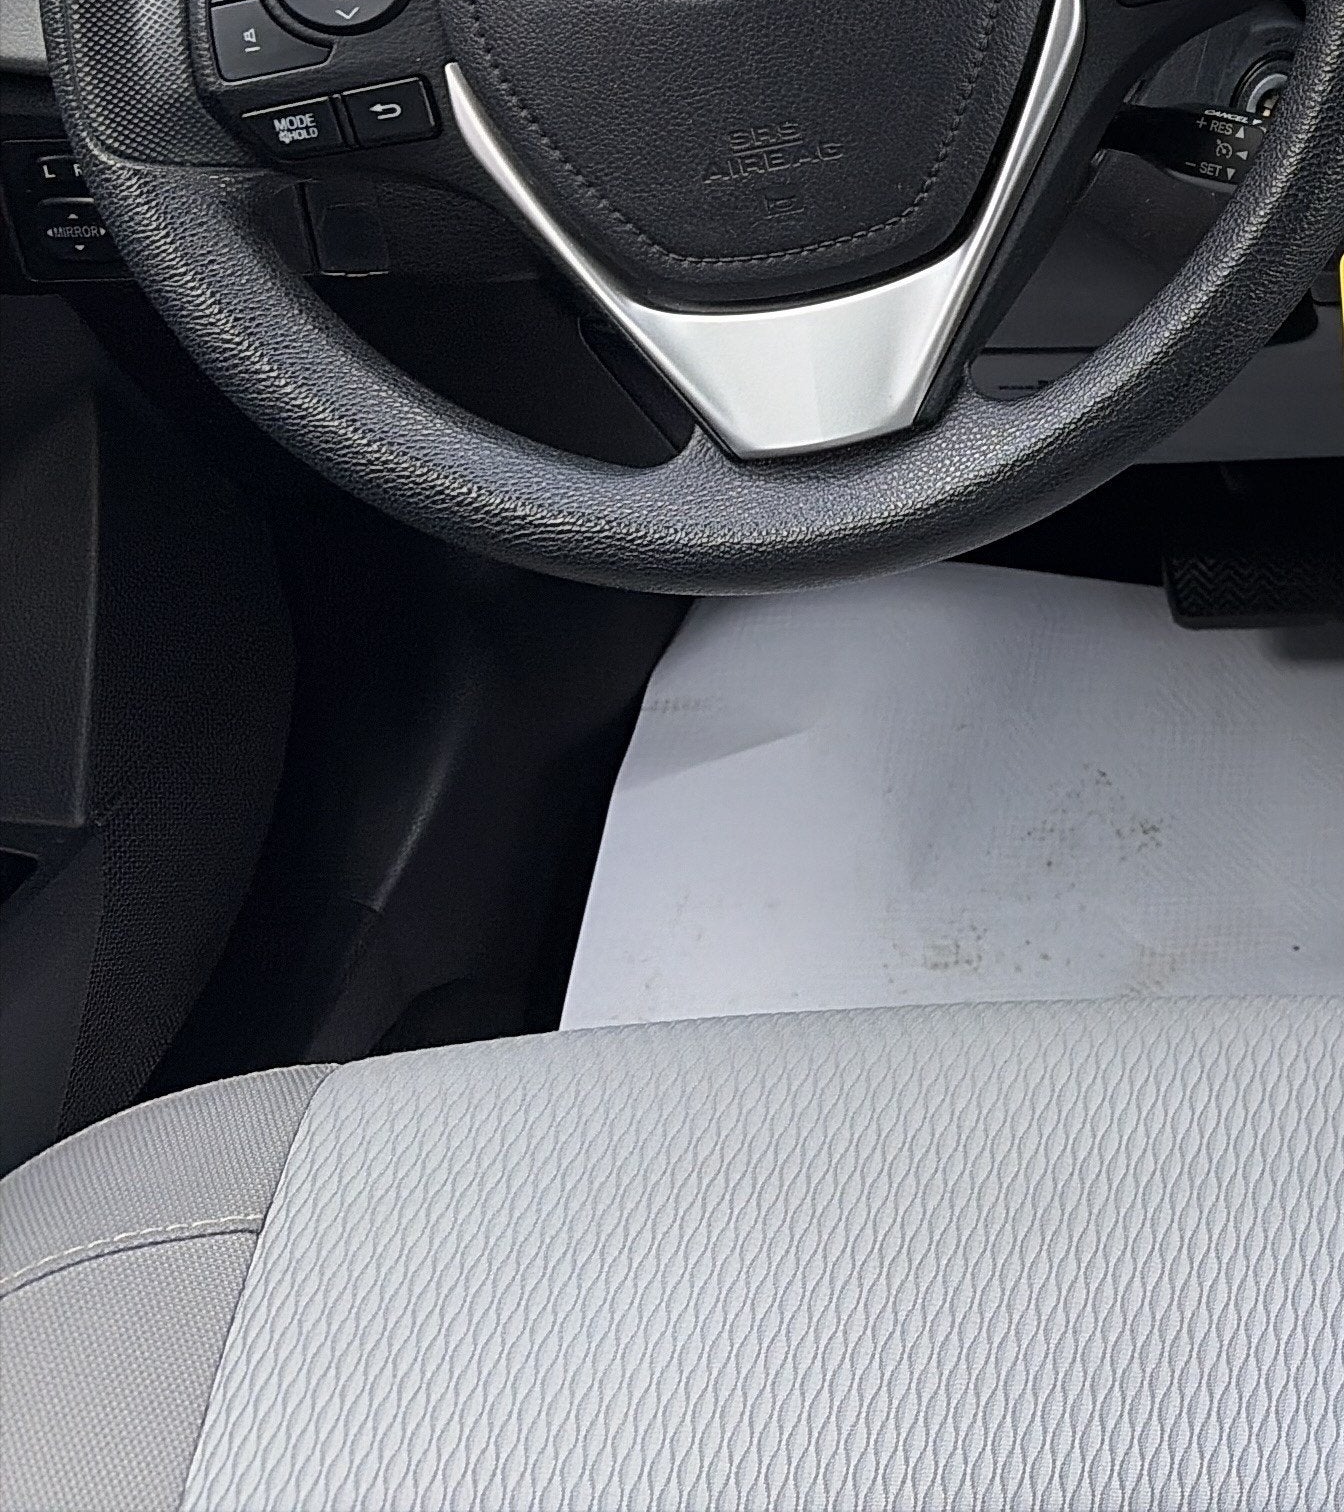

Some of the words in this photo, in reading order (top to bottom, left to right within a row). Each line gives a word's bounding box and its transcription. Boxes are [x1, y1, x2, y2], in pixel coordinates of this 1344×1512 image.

[273, 113, 316, 132] MODE
[1210, 120, 1233, 135] RES
[289, 128, 318, 141] HOLD
[730, 122, 801, 150] SRS
[703, 143, 844, 183] AIRBAG
[1200, 162, 1222, 177] SET
[43, 165, 56, 179] L
[54, 226, 100, 238] MIRROR
